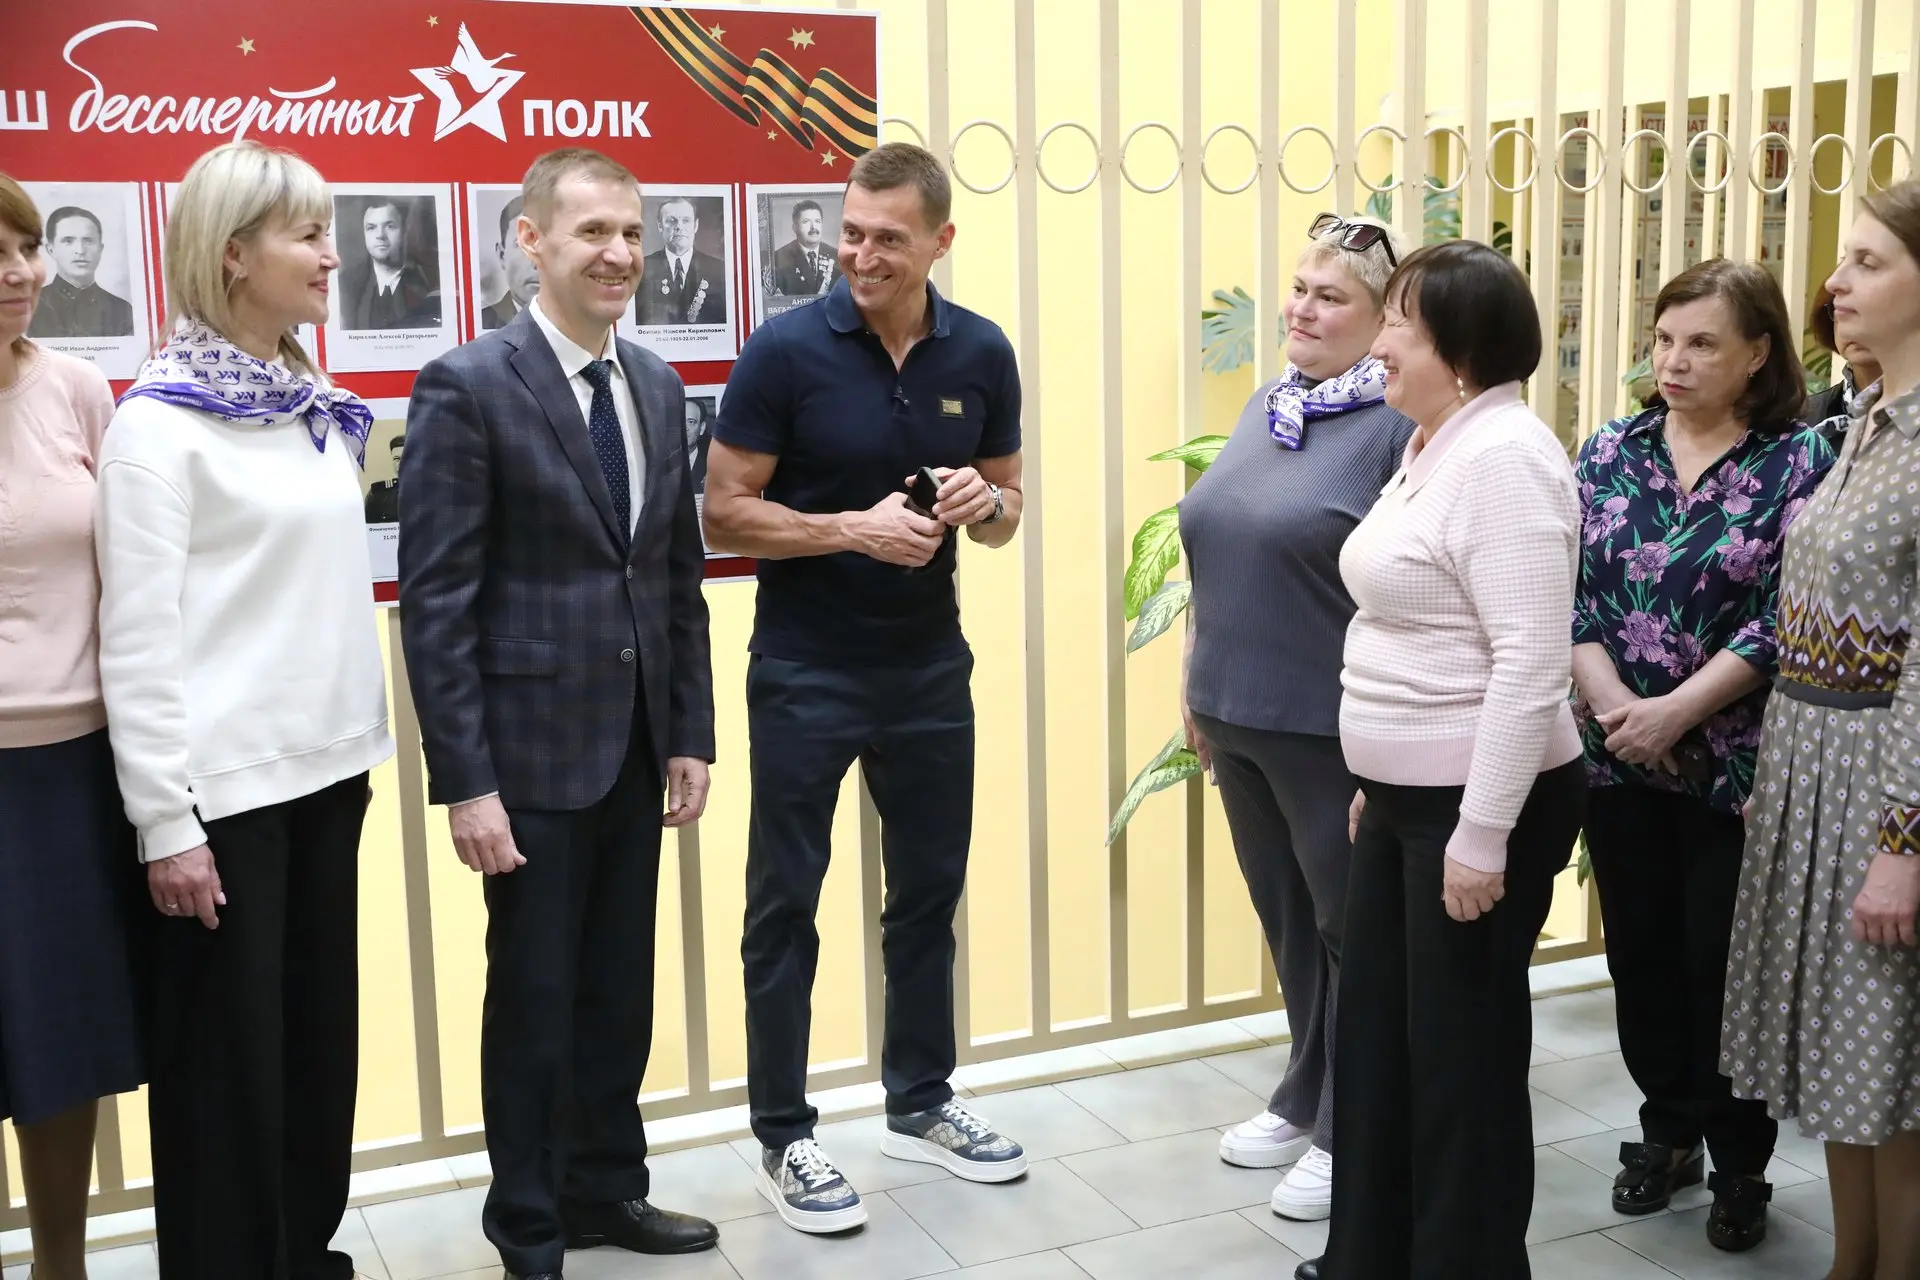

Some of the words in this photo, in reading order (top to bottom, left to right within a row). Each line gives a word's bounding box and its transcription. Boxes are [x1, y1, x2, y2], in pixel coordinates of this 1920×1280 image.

[0, 89, 48, 130] Ш
[63, 20, 424, 144] бессмертный
[523, 98, 652, 138] ПОЛК
[791, 297, 815, 306] АНТО
[688, 327, 726, 335] Кириллович
